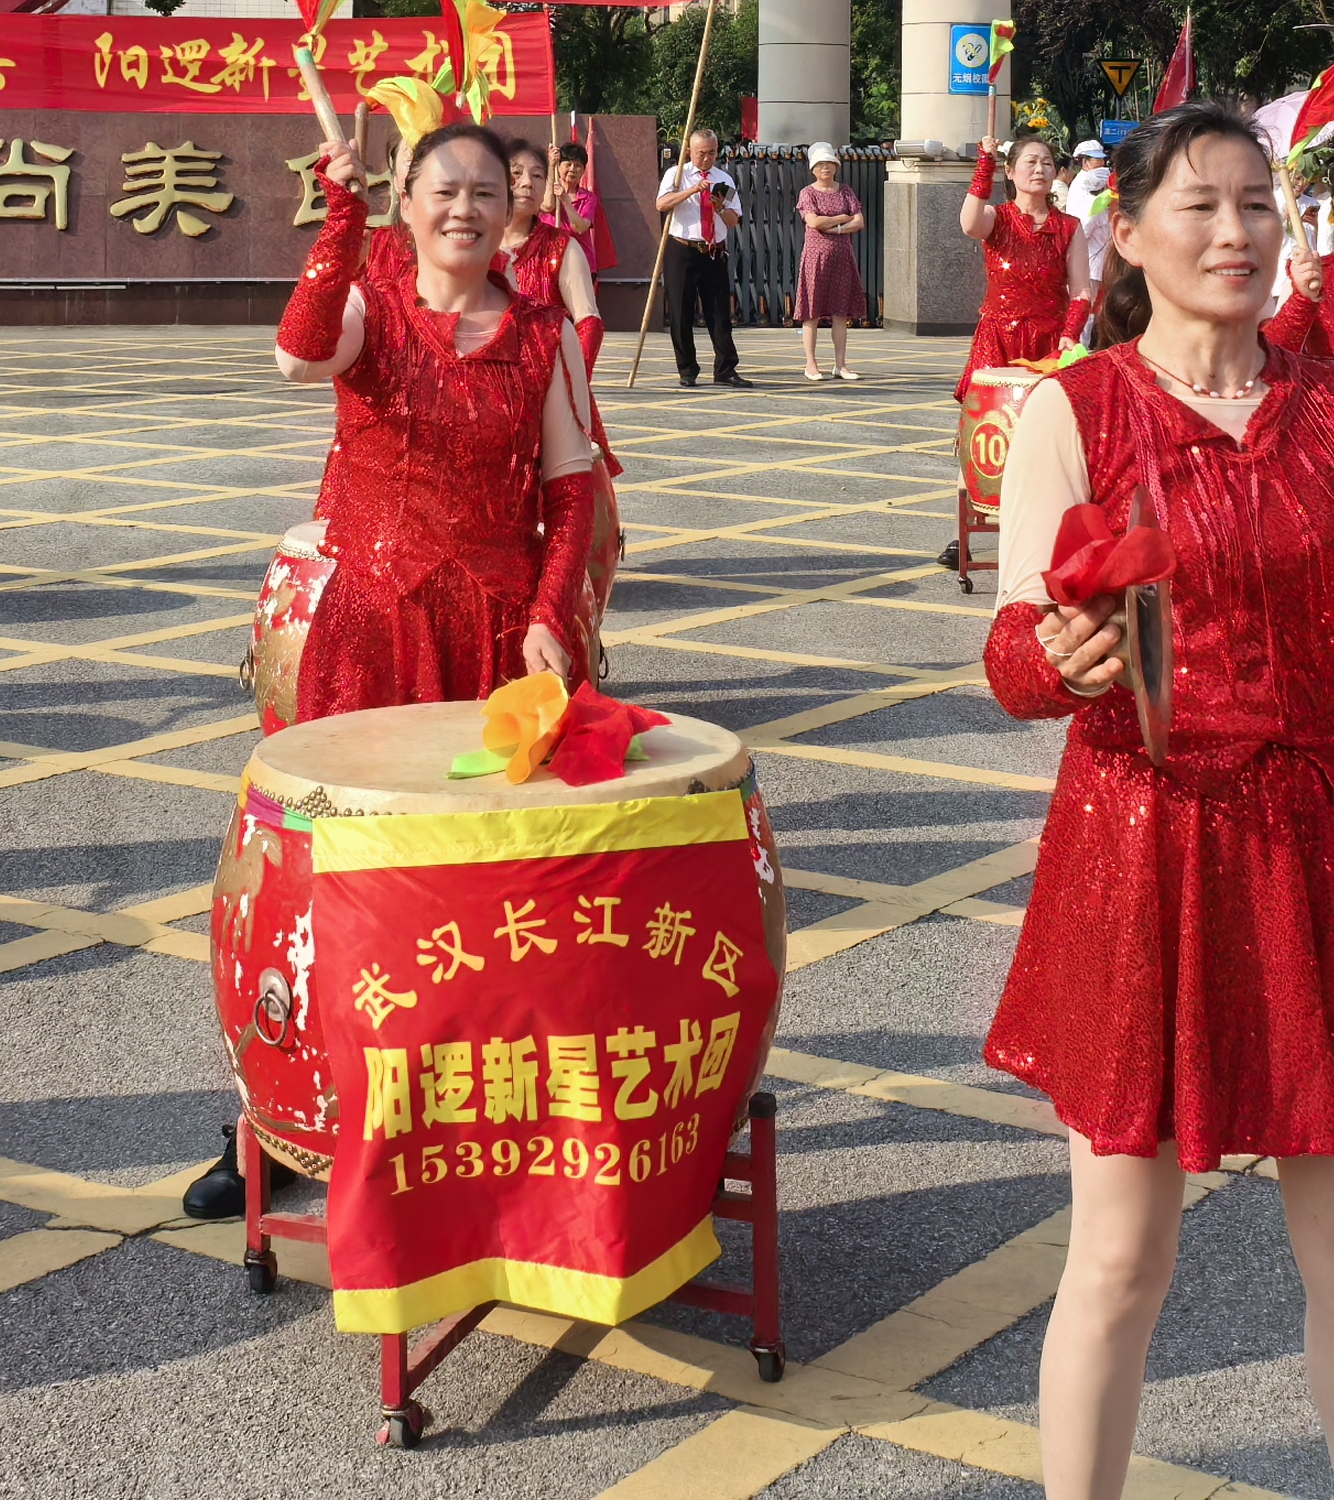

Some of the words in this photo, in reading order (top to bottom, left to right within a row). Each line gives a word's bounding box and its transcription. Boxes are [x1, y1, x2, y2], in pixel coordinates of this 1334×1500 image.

[975, 433, 1007, 468] 10
[350, 894, 745, 1031] 武汉长江新区
[361, 1011, 741, 1142] 阳逻新星艺术团
[388, 1112, 700, 1196] 15392926163
